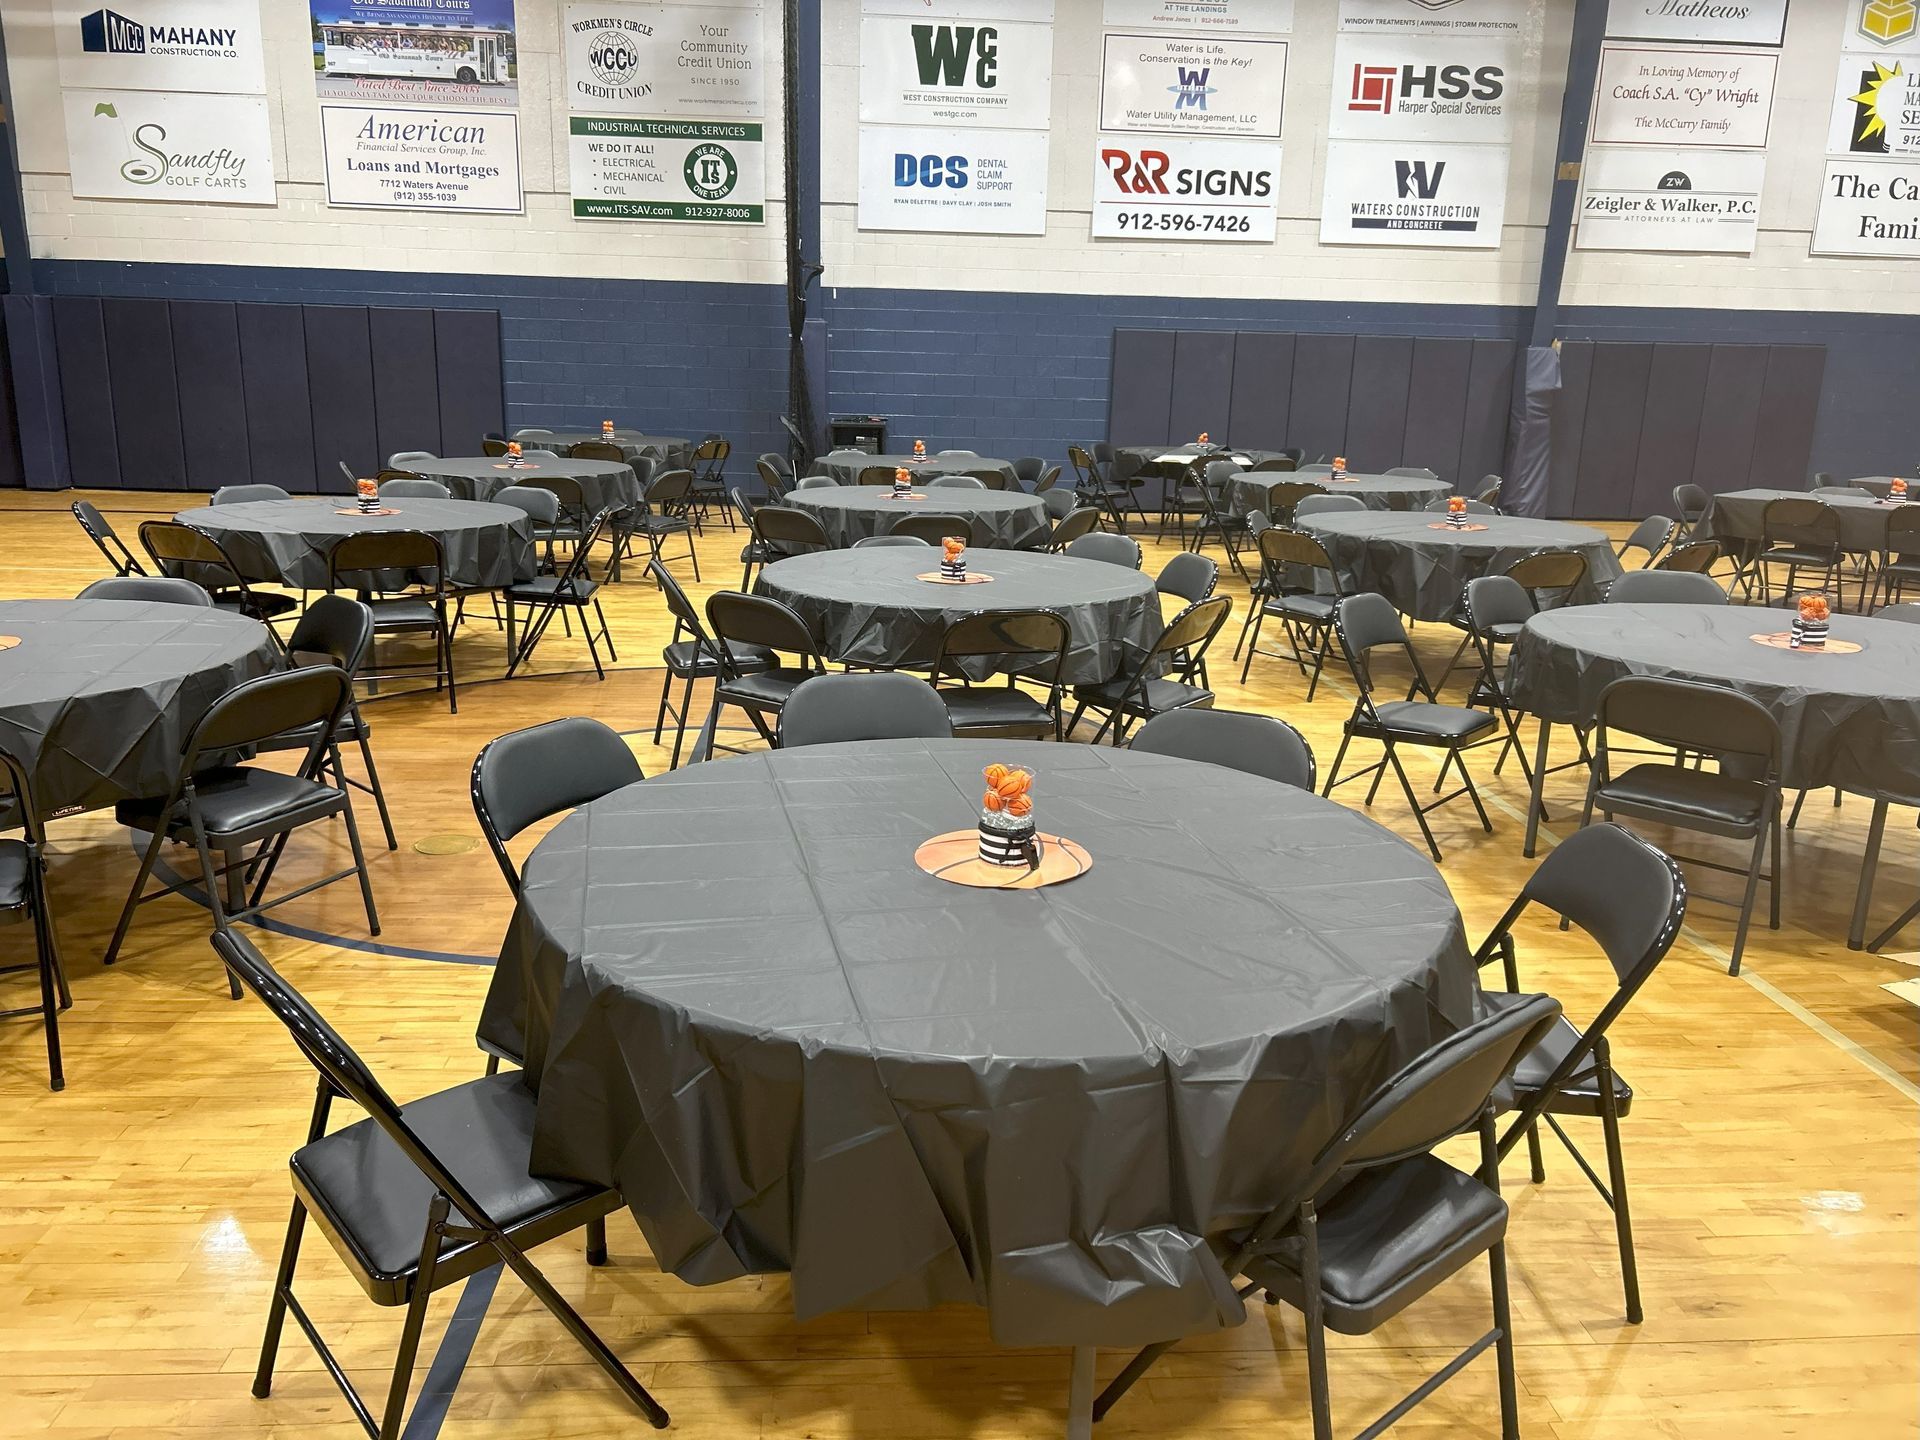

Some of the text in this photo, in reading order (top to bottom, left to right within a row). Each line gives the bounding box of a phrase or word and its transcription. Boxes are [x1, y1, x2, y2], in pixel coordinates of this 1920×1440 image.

[437, 0, 470, 9] Tours
[1646, 0, 1750, 19] Mathews
[111, 16, 143, 51] MCC
[572, 18, 654, 37] WORKMEN'S CIRCLE
[700, 25, 729, 37] Your
[150, 27, 237, 46] MAHANY
[150, 47, 239, 58] CONSTRUCTION CO.
[681, 41, 748, 55] Community
[1166, 43, 1226, 54] Water is Life.
[590, 48, 637, 70] WCCU
[678, 56, 752, 70] Credit Union
[1139, 54, 1253, 69] Conservation is the Key!
[691, 77, 740, 86] SINCE 1950
[1639, 66, 1741, 83] In Loving Memory of
[352, 79, 385, 90] Voted
[388, 80, 415, 91] Best
[420, 81, 448, 92] Since
[1401, 65, 1504, 100] HSS
[577, 80, 653, 100] CREDIT UNION
[1613, 86, 1650, 100] Coach
[1653, 87, 1679, 100] S.A.
[1716, 89, 1759, 108] Wright
[923, 95, 975, 103] CONSTRUCTION
[976, 97, 1008, 105] COMPANY
[1399, 100, 1501, 115] Harper Special Services
[1126, 110, 1257, 123] Water Utility Management, LLC
[356, 114, 485, 144] American
[588, 122, 746, 137] INDUSTRIAL TECHNICAL SERVICES
[1635, 117, 1731, 134] The McCurry Family
[126, 124, 246, 179] Sandfly
[357, 141, 487, 157] Financial Services Group, Inc.
[588, 143, 654, 154] WE DO IT ALL!
[695, 147, 725, 158] WE ARE
[347, 158, 499, 179] Loans and Mortgages
[603, 158, 655, 168] ELECTRICAL
[978, 159, 1008, 168] DENTAL
[603, 172, 664, 182] MECHANICAL
[895, 154, 969, 188] DCS
[977, 170, 1002, 179] CLAIM
[1102, 149, 1272, 197] R&R SIGNS
[166, 176, 247, 188] GOLF CARTS
[380, 180, 469, 191] 7712 Waters Avenue
[977, 181, 1013, 191] SUPPORT
[1666, 178, 1685, 187] ZW
[1831, 175, 1880, 199] The
[394, 191, 456, 201] (912) 355-1039
[603, 186, 626, 195] CIVIL
[694, 185, 729, 198] ONE TEAM
[587, 205, 750, 218] www.ITS-SAV.com 912-927-8006
[1352, 203, 1480, 218] WATERS CONSTRUCTION
[1585, 197, 1756, 213] Zeigler & Walker, P.C.
[1118, 213, 1250, 232] 912-596-7426
[1387, 220, 1443, 230] AND CONCRETE
